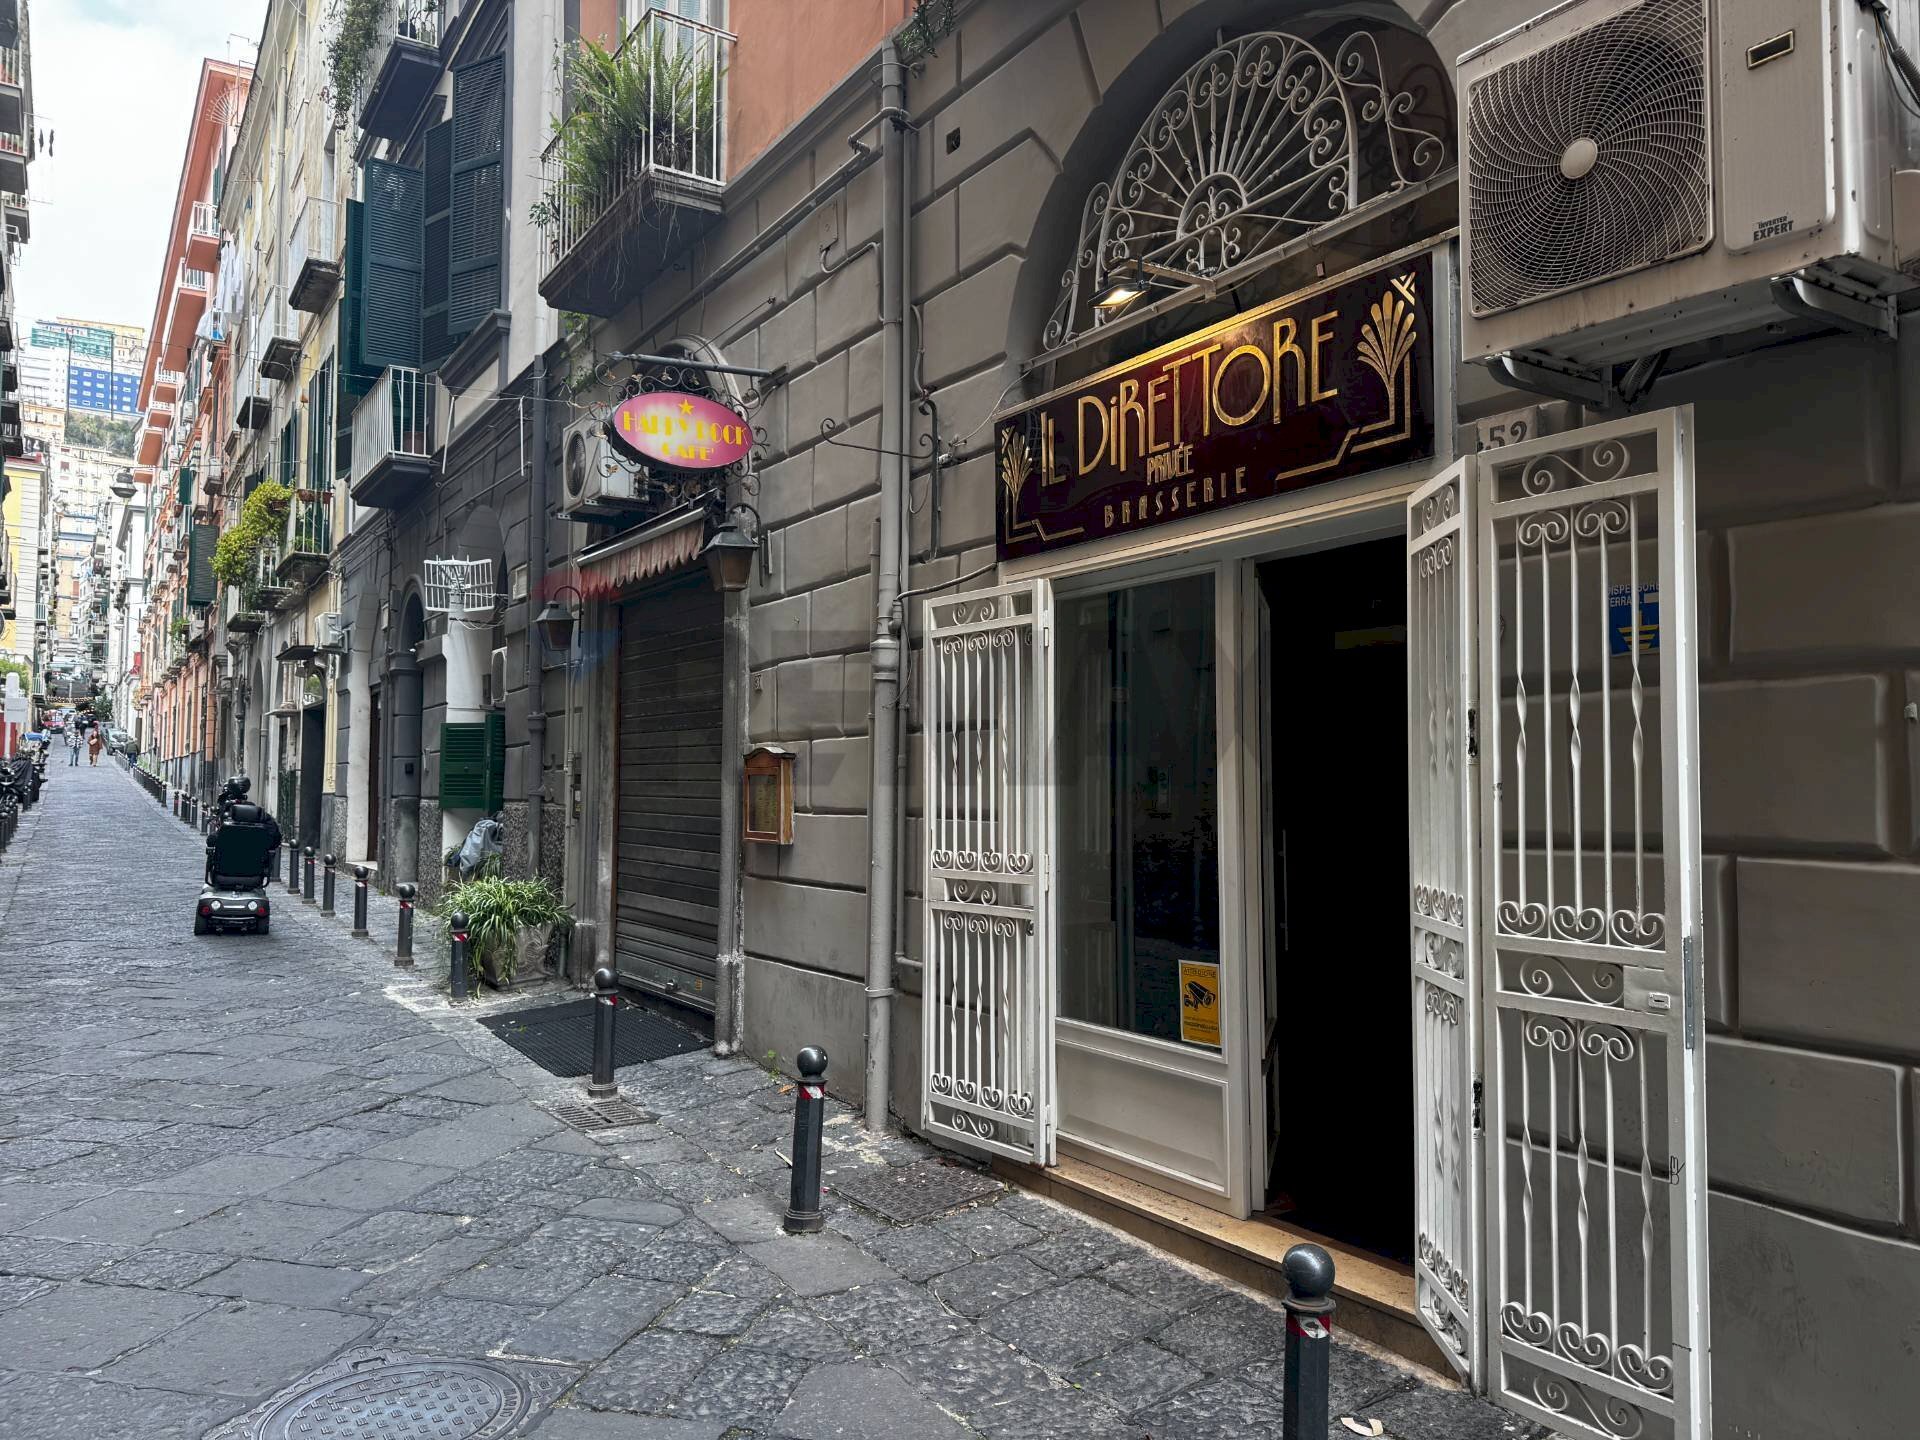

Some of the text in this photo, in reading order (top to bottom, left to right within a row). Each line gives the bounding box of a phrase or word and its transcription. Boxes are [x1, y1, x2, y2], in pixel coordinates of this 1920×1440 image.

[1753, 220, 1794, 241] EXPERT
[1041, 410, 1066, 488] IL
[1489, 420, 1528, 448] 52
[1104, 466, 1247, 529] BRASSERIE
